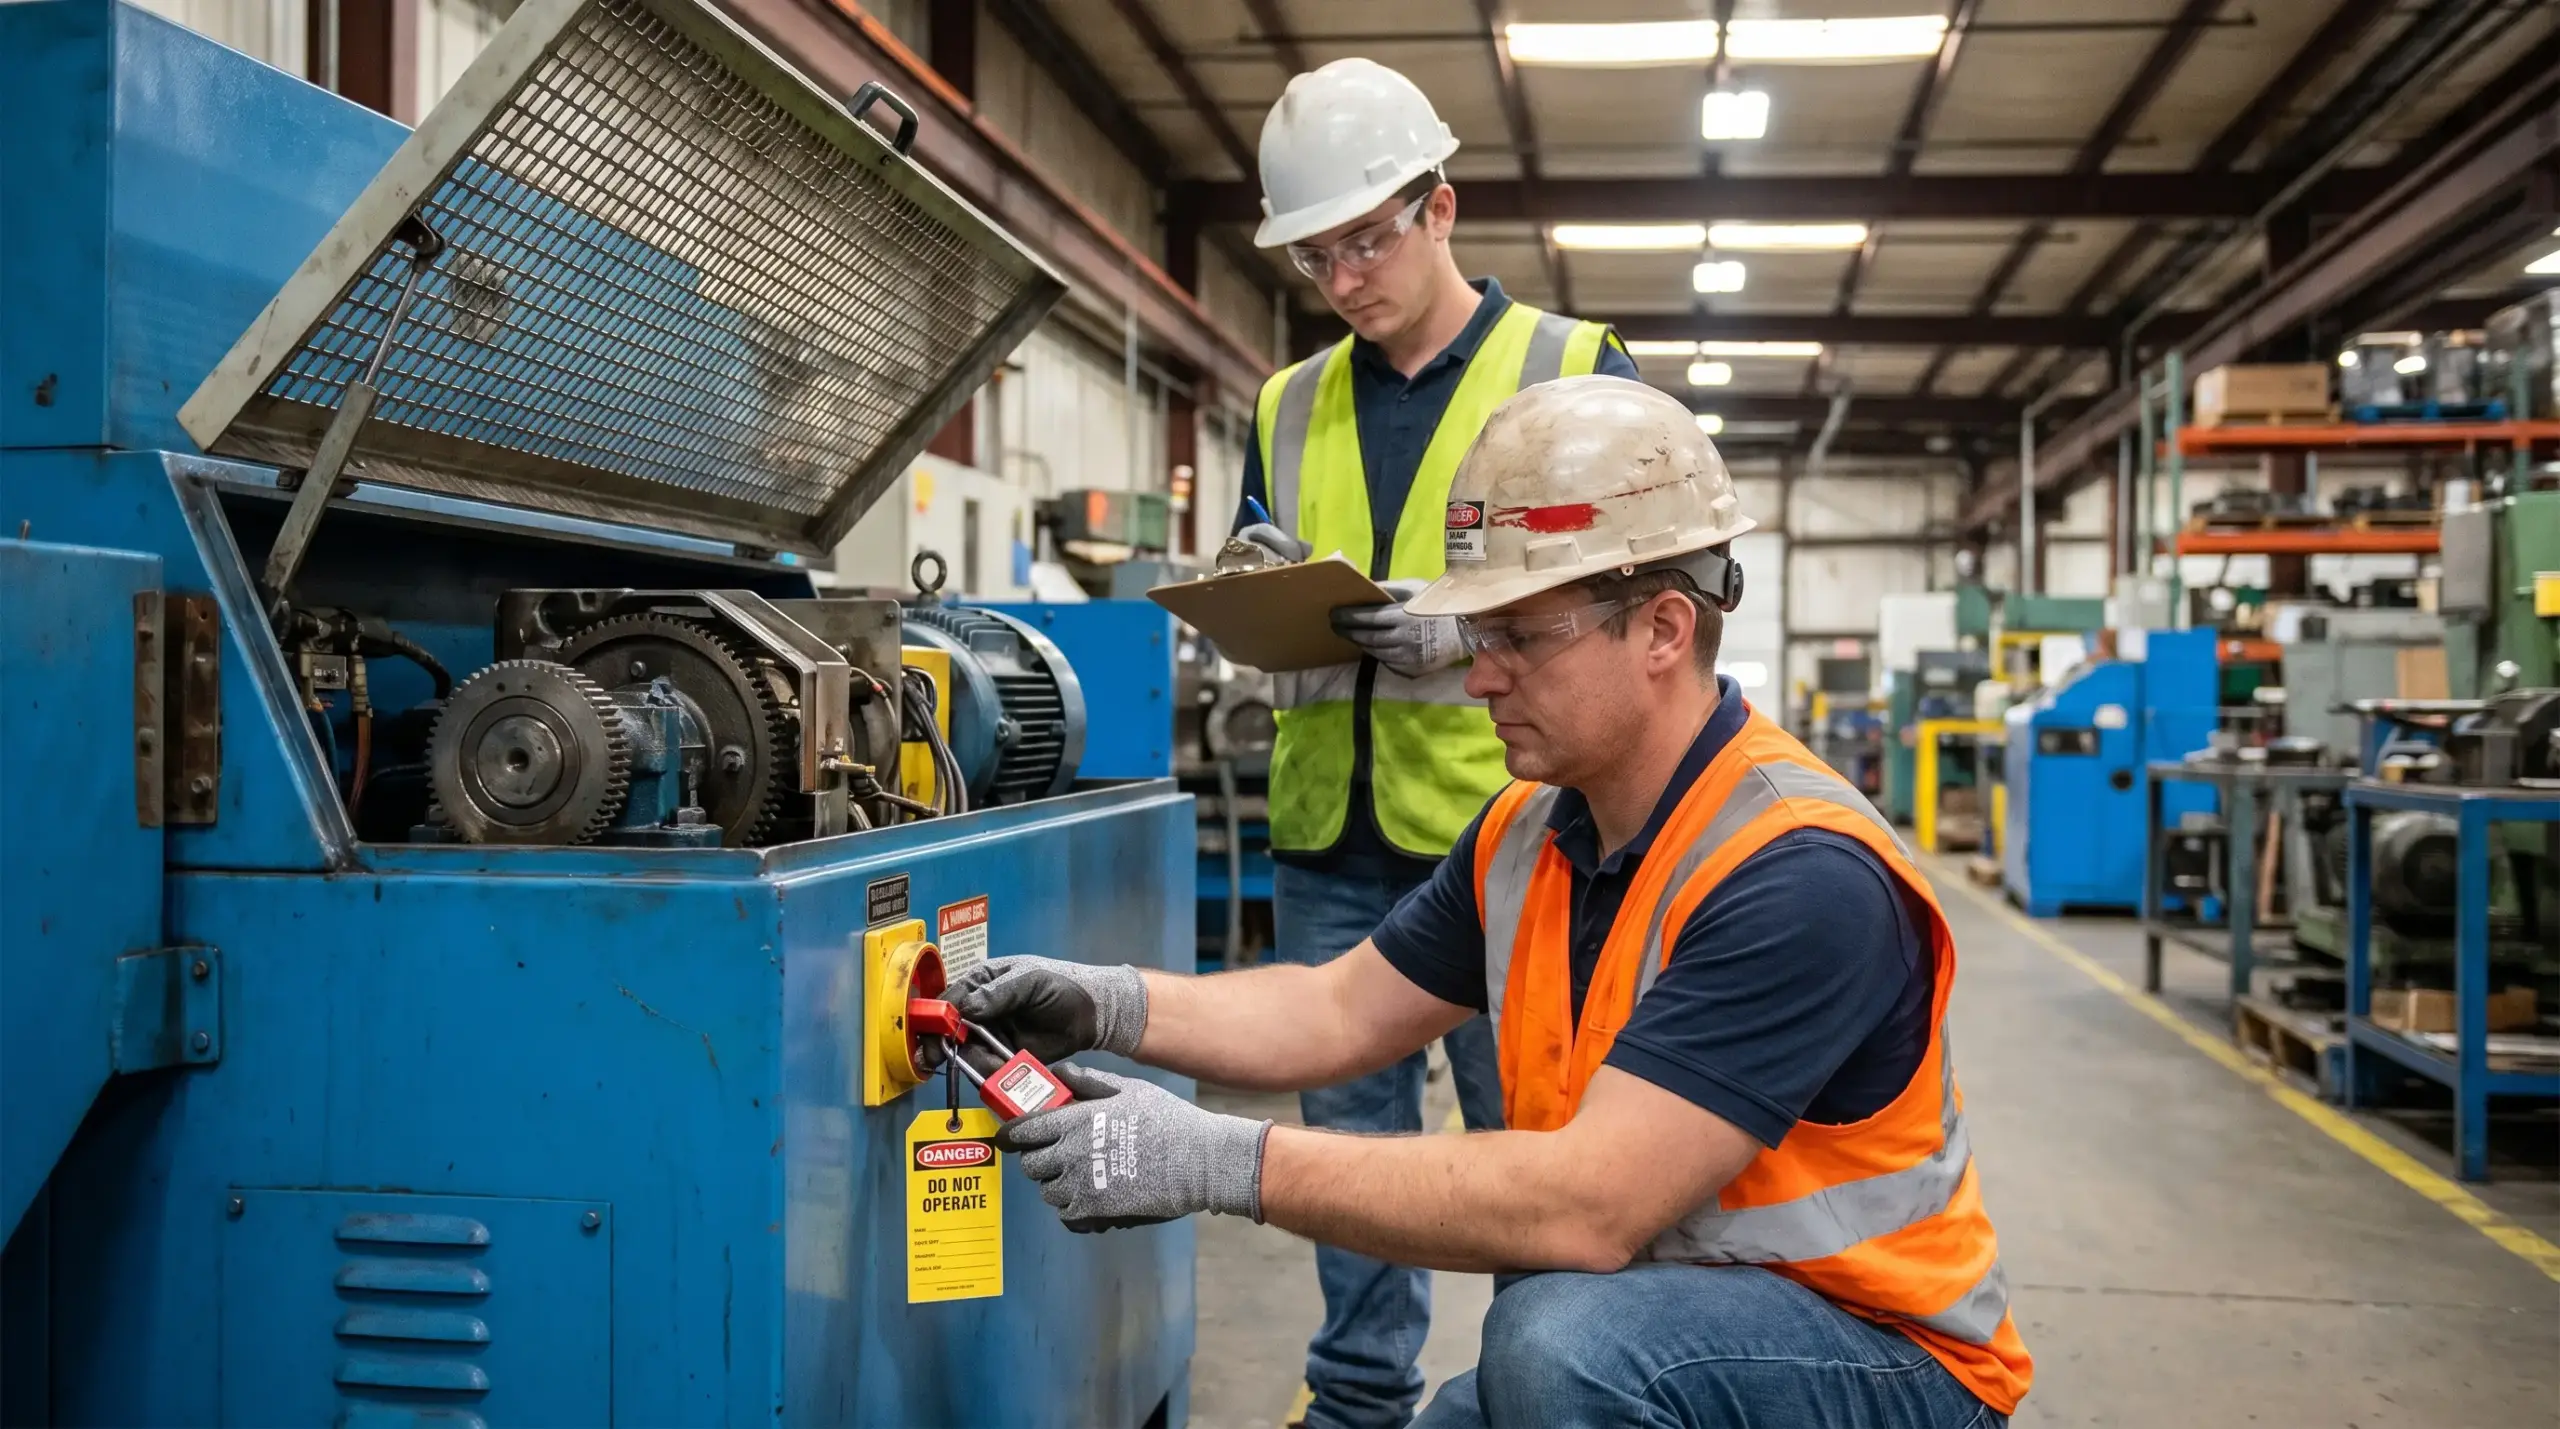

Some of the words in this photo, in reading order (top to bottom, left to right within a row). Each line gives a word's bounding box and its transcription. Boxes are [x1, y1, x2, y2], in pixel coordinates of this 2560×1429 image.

[923, 1146, 985, 1163] DANGER
[928, 1178, 947, 1194] DO
[952, 1175, 981, 1192] NOT
[922, 1194, 987, 1213] OPERATE
